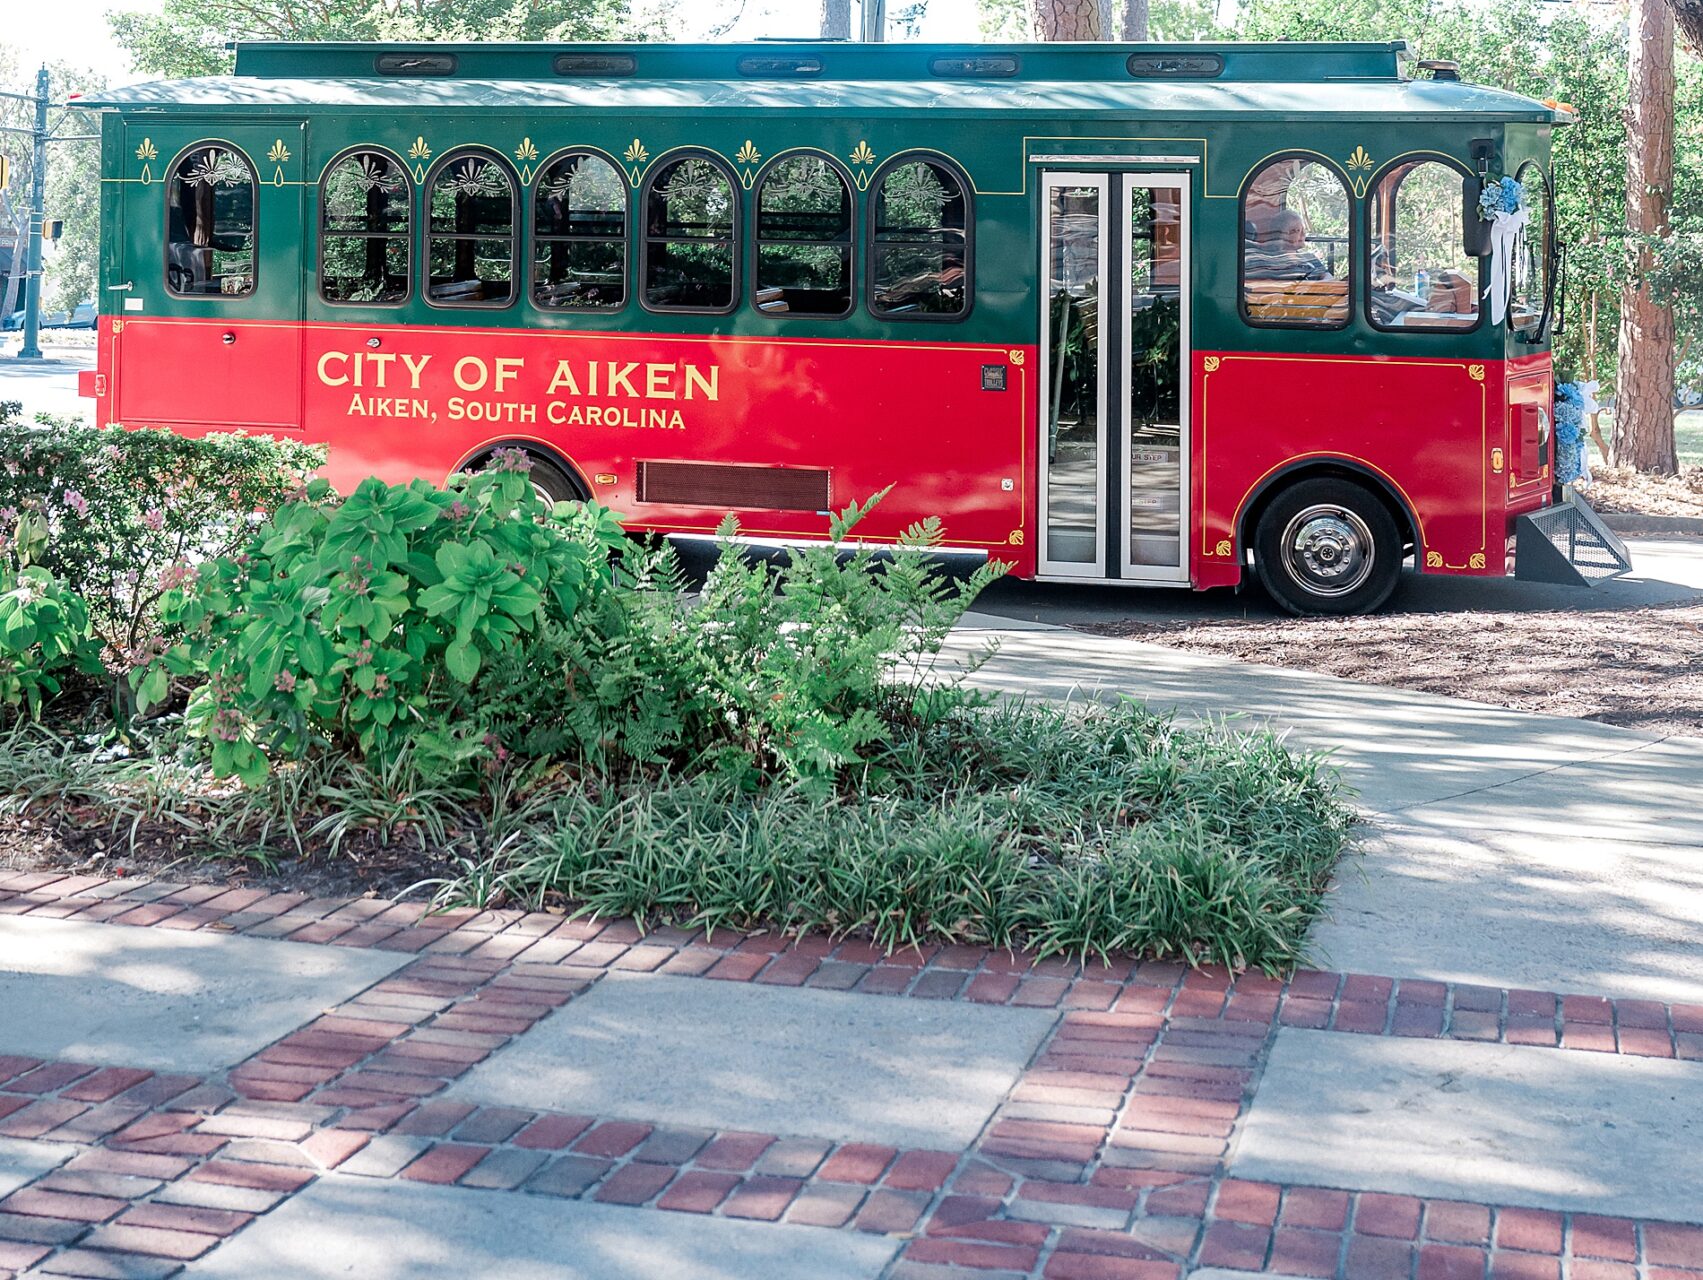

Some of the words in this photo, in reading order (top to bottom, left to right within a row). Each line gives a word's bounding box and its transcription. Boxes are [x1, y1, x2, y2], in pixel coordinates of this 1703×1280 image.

[316, 350, 432, 389] CITY
[453, 356, 525, 393] OF
[546, 359, 720, 401] AIKEN
[346, 393, 437, 424] AIKEN,
[447, 396, 536, 423] SOUTH
[546, 400, 686, 429] CAROLINA
